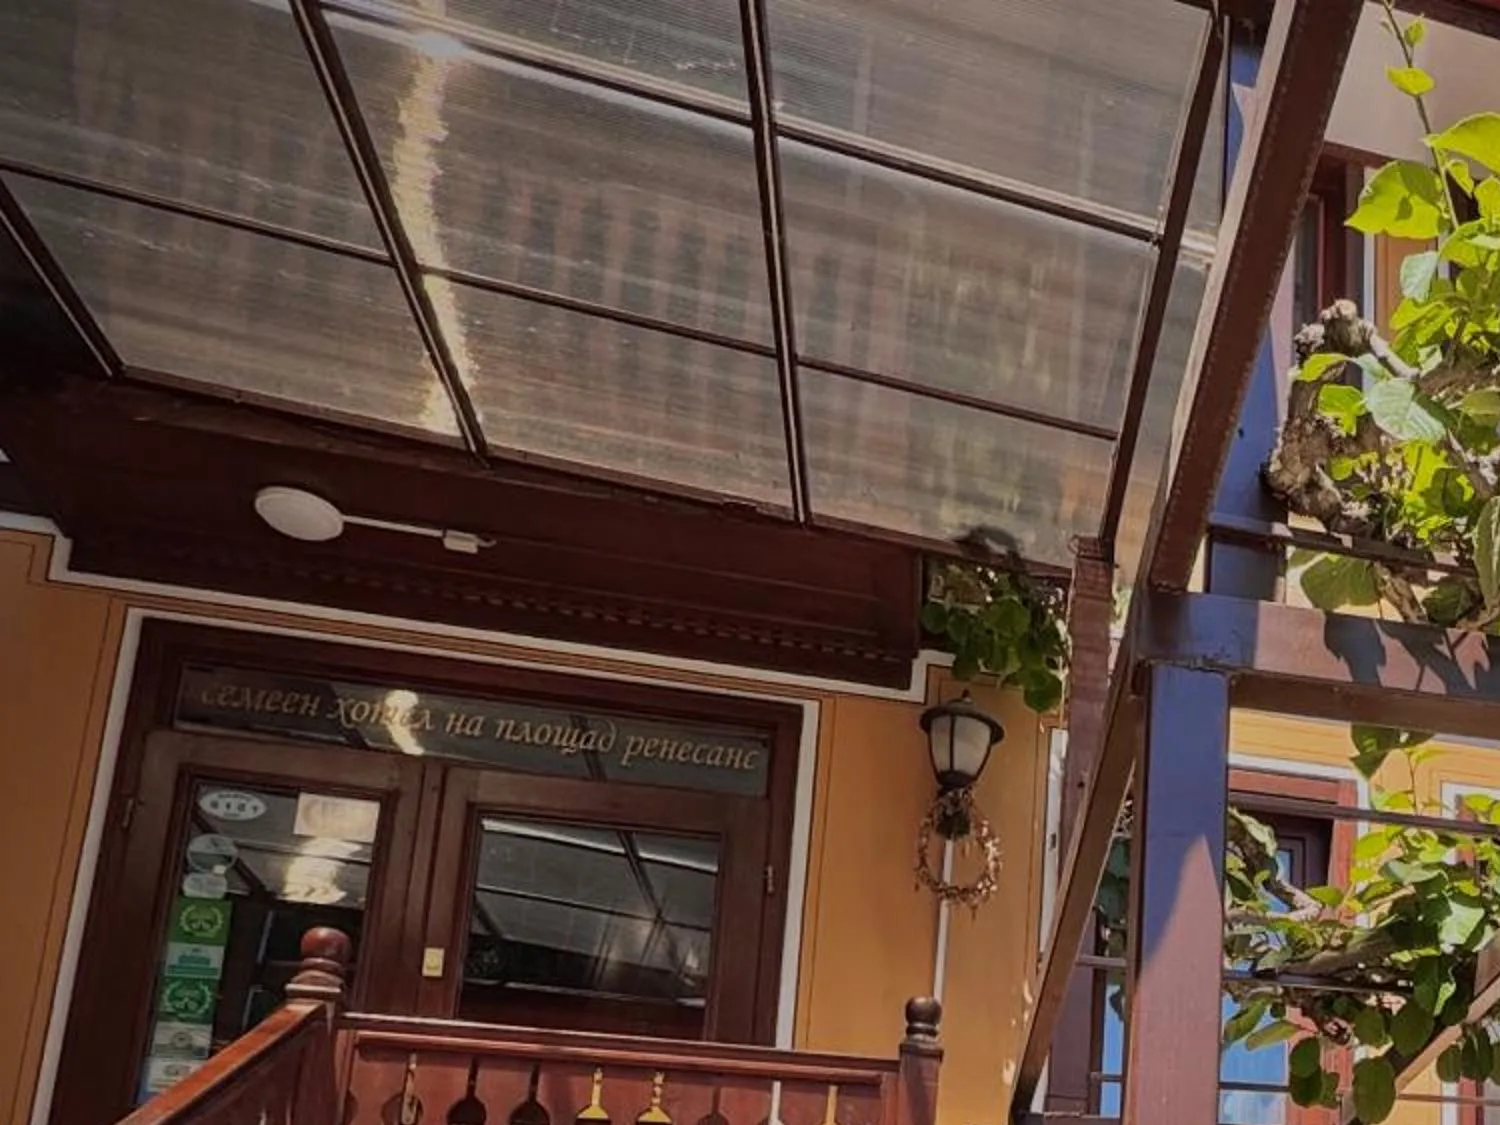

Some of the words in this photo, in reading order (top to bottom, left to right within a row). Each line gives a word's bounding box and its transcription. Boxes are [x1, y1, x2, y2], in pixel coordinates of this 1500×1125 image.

[200, 683, 321, 717] семеен
[445, 711, 483, 737] на
[495, 717, 619, 754] площад
[620, 732, 759, 770] ренесанс
